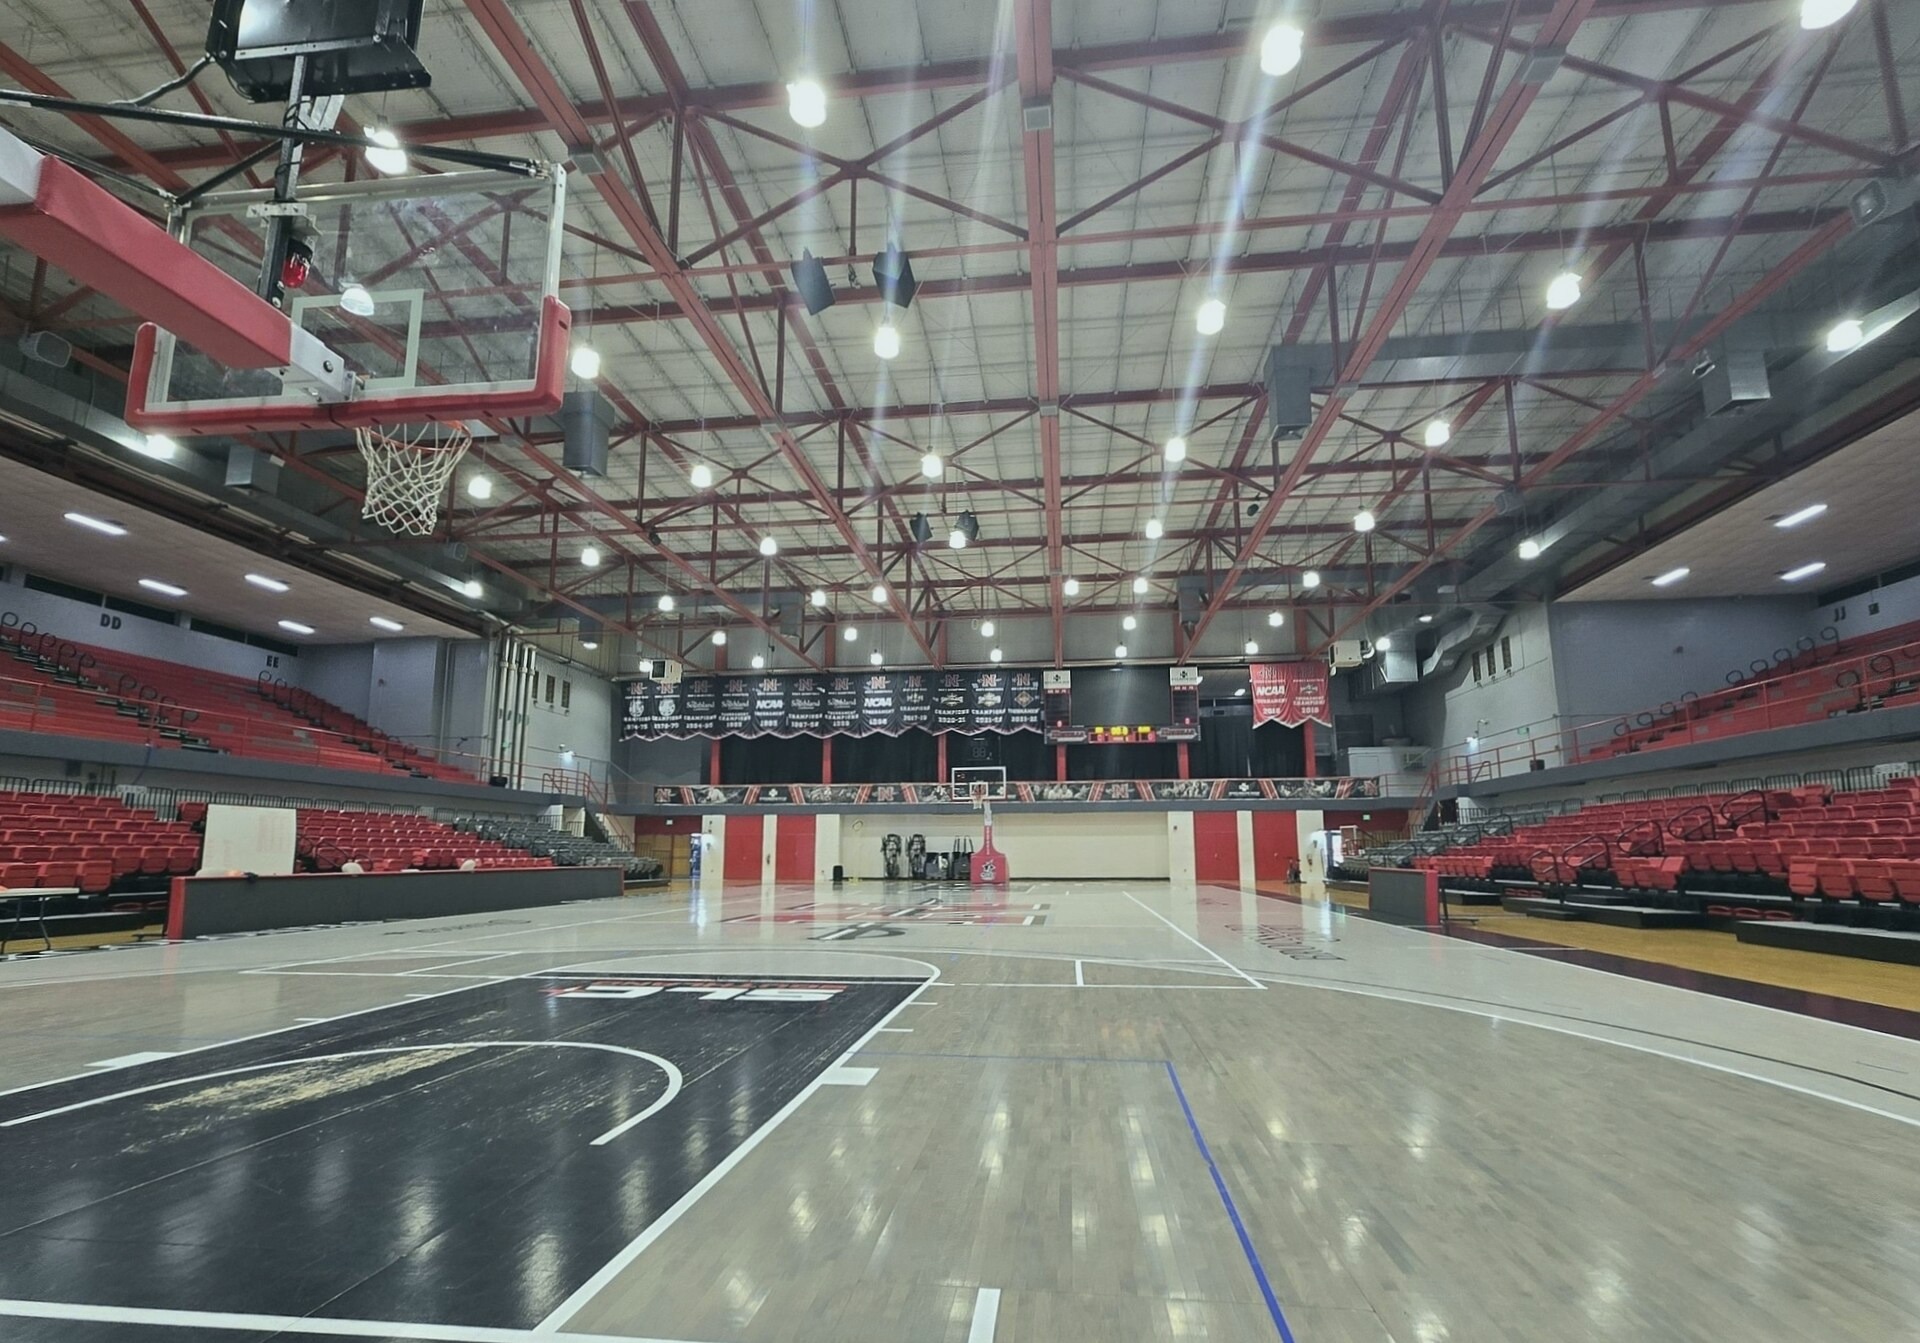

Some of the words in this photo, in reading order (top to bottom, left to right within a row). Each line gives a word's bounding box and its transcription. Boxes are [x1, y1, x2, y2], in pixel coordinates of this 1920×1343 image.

[1834, 606, 1846, 622] JJ
[100, 613, 122, 630] DD
[266, 655, 279, 668] EE
[763, 678, 777, 691] N
[871, 676, 886, 690] N
[982, 674, 997, 687] N
[1256, 685, 1286, 696] NCAA
[756, 700, 784, 710] NCAA
[864, 697, 892, 708] NCAA
[555, 985, 846, 1001] SLC
